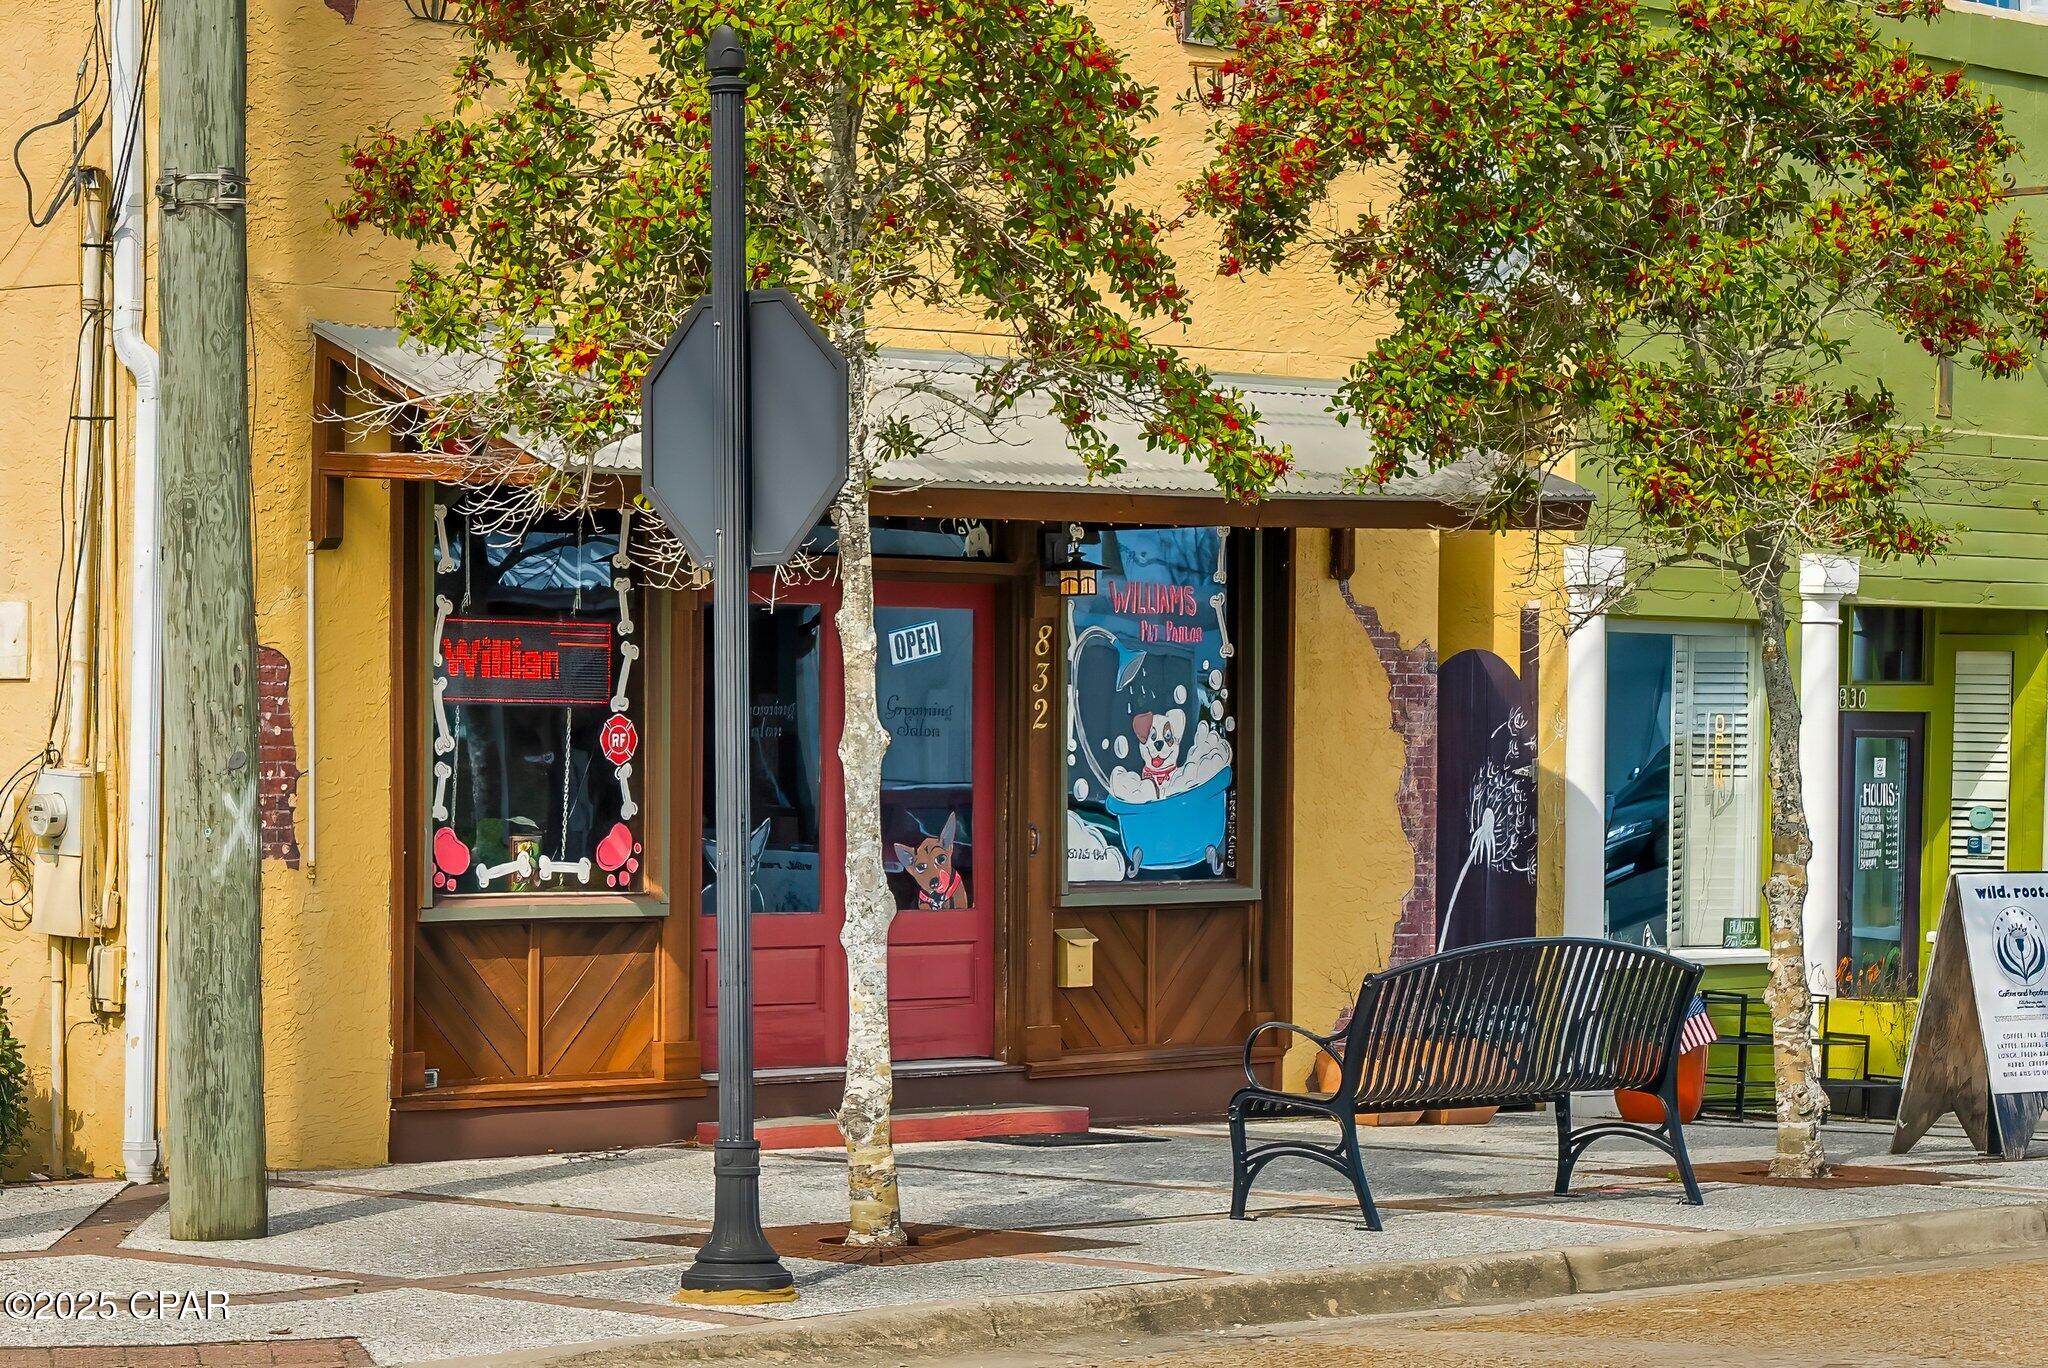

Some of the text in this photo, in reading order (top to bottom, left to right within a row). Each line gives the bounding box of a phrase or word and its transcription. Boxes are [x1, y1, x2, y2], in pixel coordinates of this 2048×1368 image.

[1108, 580, 1197, 617] WILLIAMS
[894, 625, 938, 661] OPEN
[1032, 624, 1053, 730] 832
[885, 694, 955, 722] Grooming
[1839, 687, 1867, 709] 830
[1974, 885, 2011, 899] wild.
